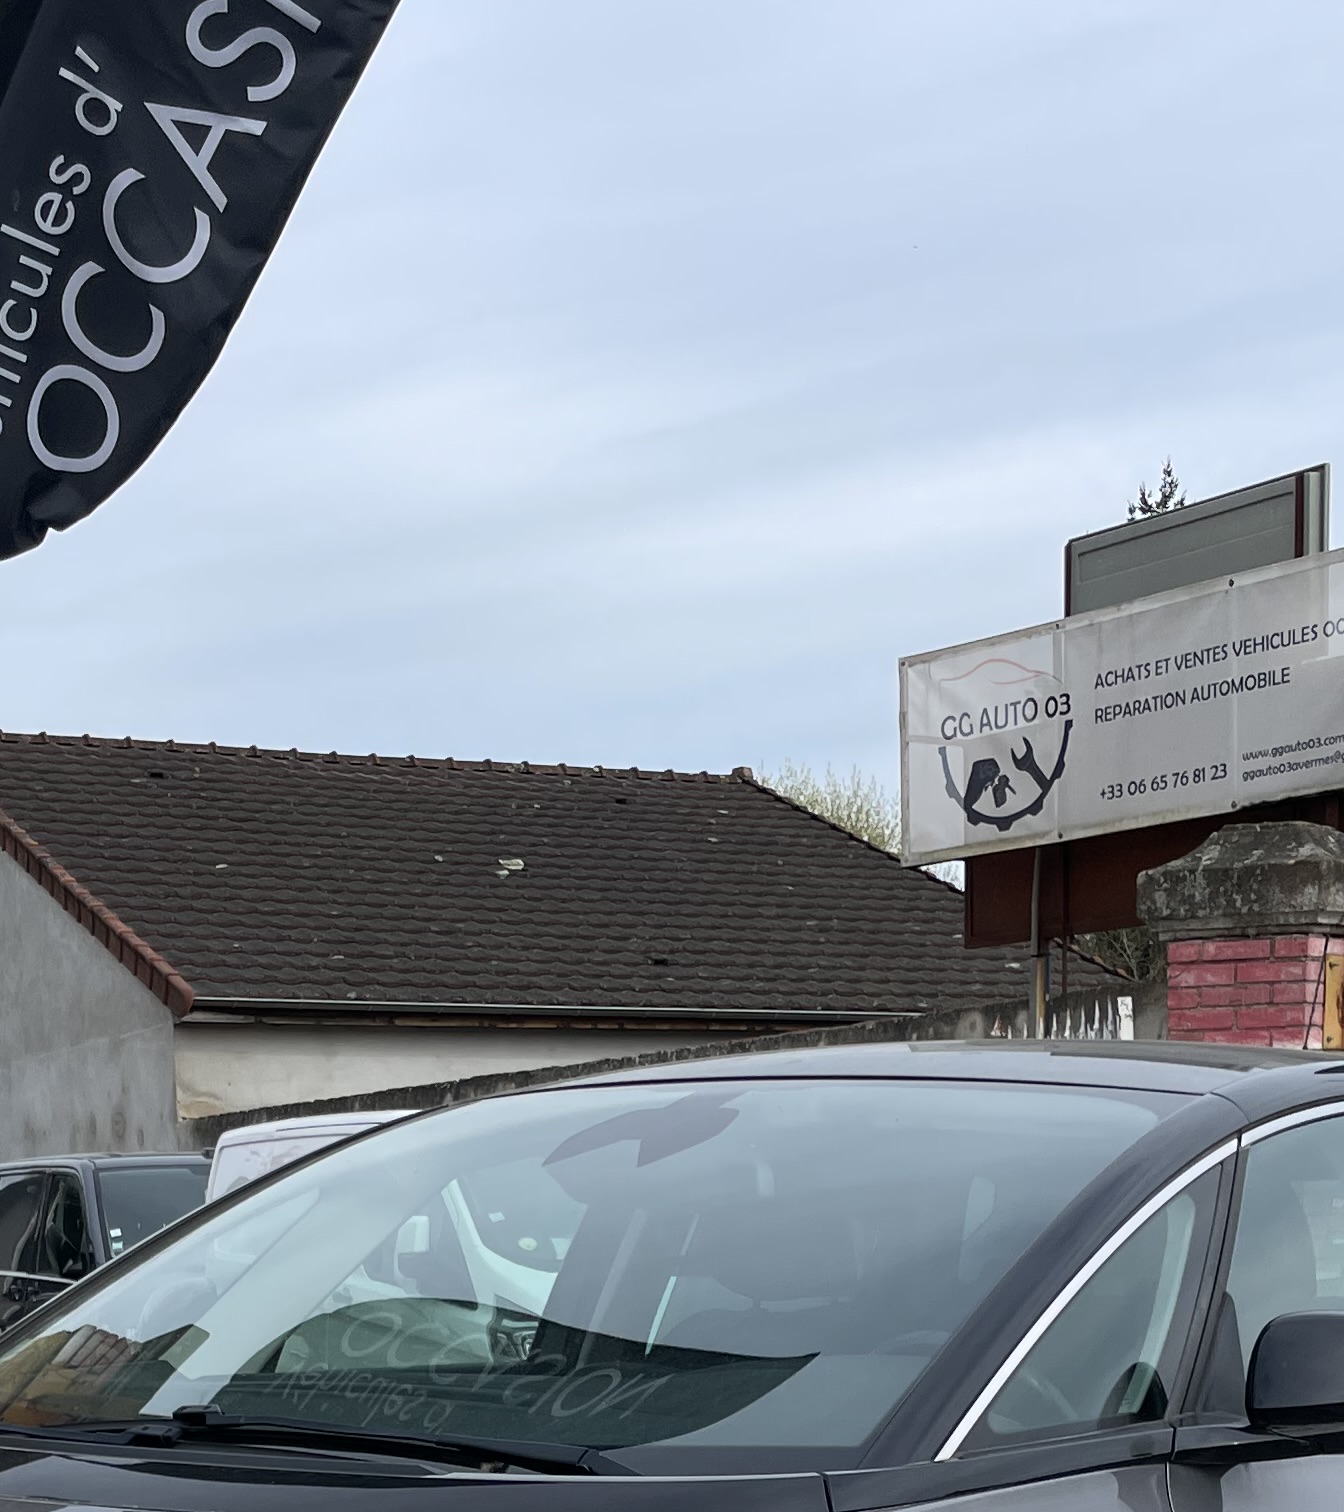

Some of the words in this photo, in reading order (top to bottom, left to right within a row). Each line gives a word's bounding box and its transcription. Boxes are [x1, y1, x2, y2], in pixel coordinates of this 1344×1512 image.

[58, 45, 123, 136] d'
[1094, 662, 1151, 690] ACHATS
[1155, 657, 1171, 677] ET
[1174, 644, 1228, 671] VENTES
[1232, 624, 1318, 658] VEHICULES
[941, 711, 974, 740] GG
[979, 697, 1038, 733] AUTO
[1044, 693, 1071, 718] 03
[1094, 690, 1186, 724] REPARATION
[1190, 667, 1291, 704] AUTOMOBILE
[1100, 783, 1123, 800] +33
[1127, 779, 1147, 796] 06
[1150, 774, 1168, 792] 65
[1172, 771, 1189, 788] 76
[1193, 767, 1206, 785] 81
[1210, 763, 1228, 781] 23
